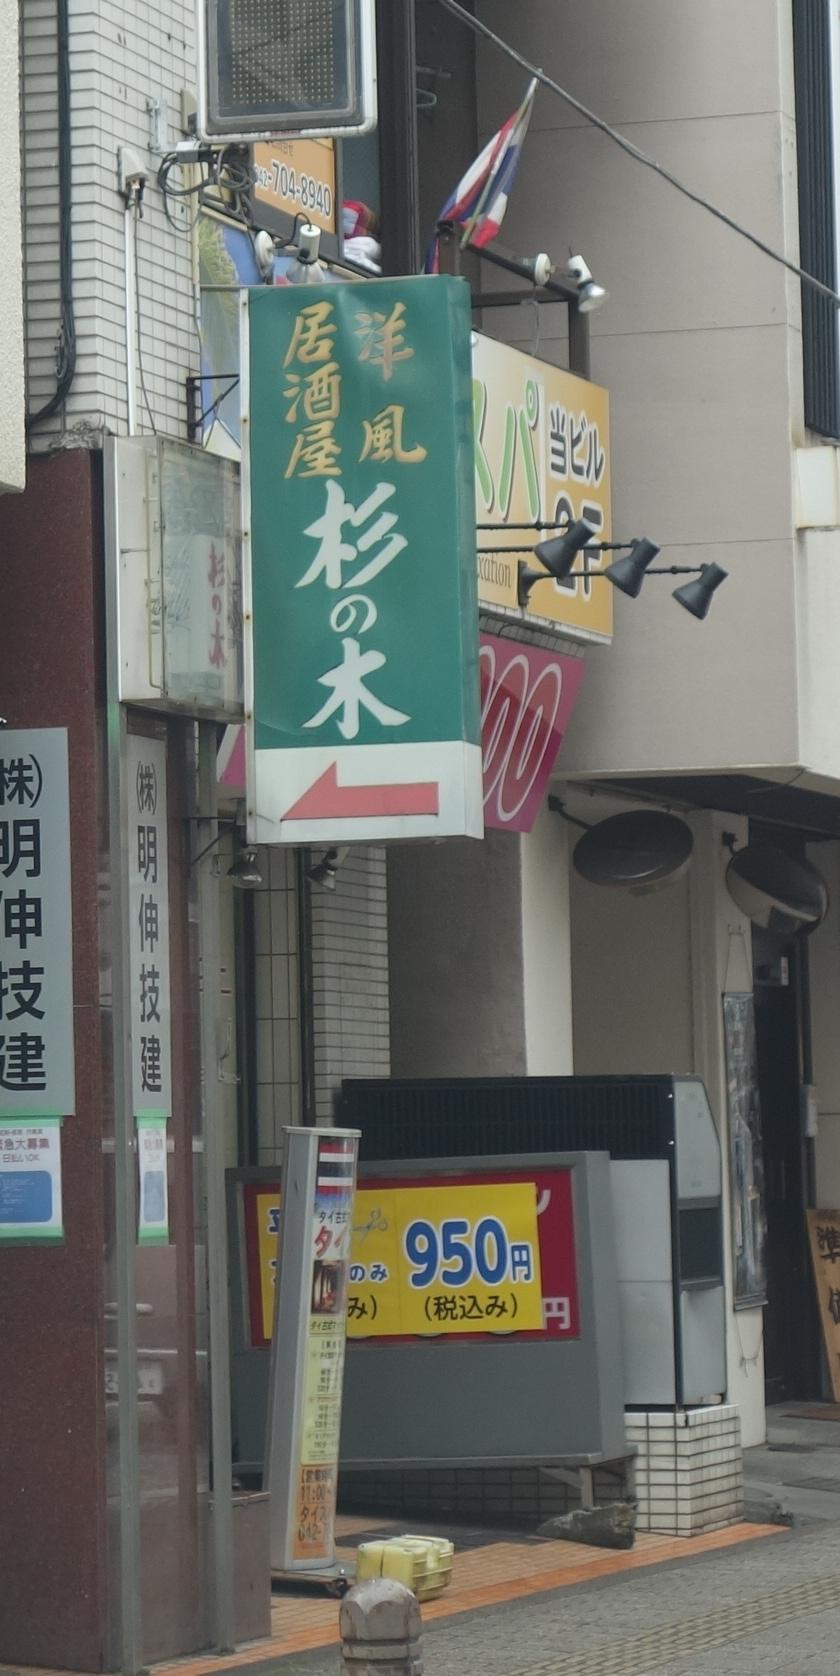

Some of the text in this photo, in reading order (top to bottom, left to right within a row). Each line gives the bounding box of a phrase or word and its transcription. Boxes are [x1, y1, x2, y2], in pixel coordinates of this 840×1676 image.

[283, 301, 342, 479] 居酒屋
[550, 405, 604, 483] 当ビル
[208, 543, 227, 668] 杉の木
[294, 479, 412, 740] 杉の木
[136, 760, 162, 1093] (株)明伸技建
[405, 1219, 532, 1287] 950円
[424, 1293, 518, 1321] (税込み)
